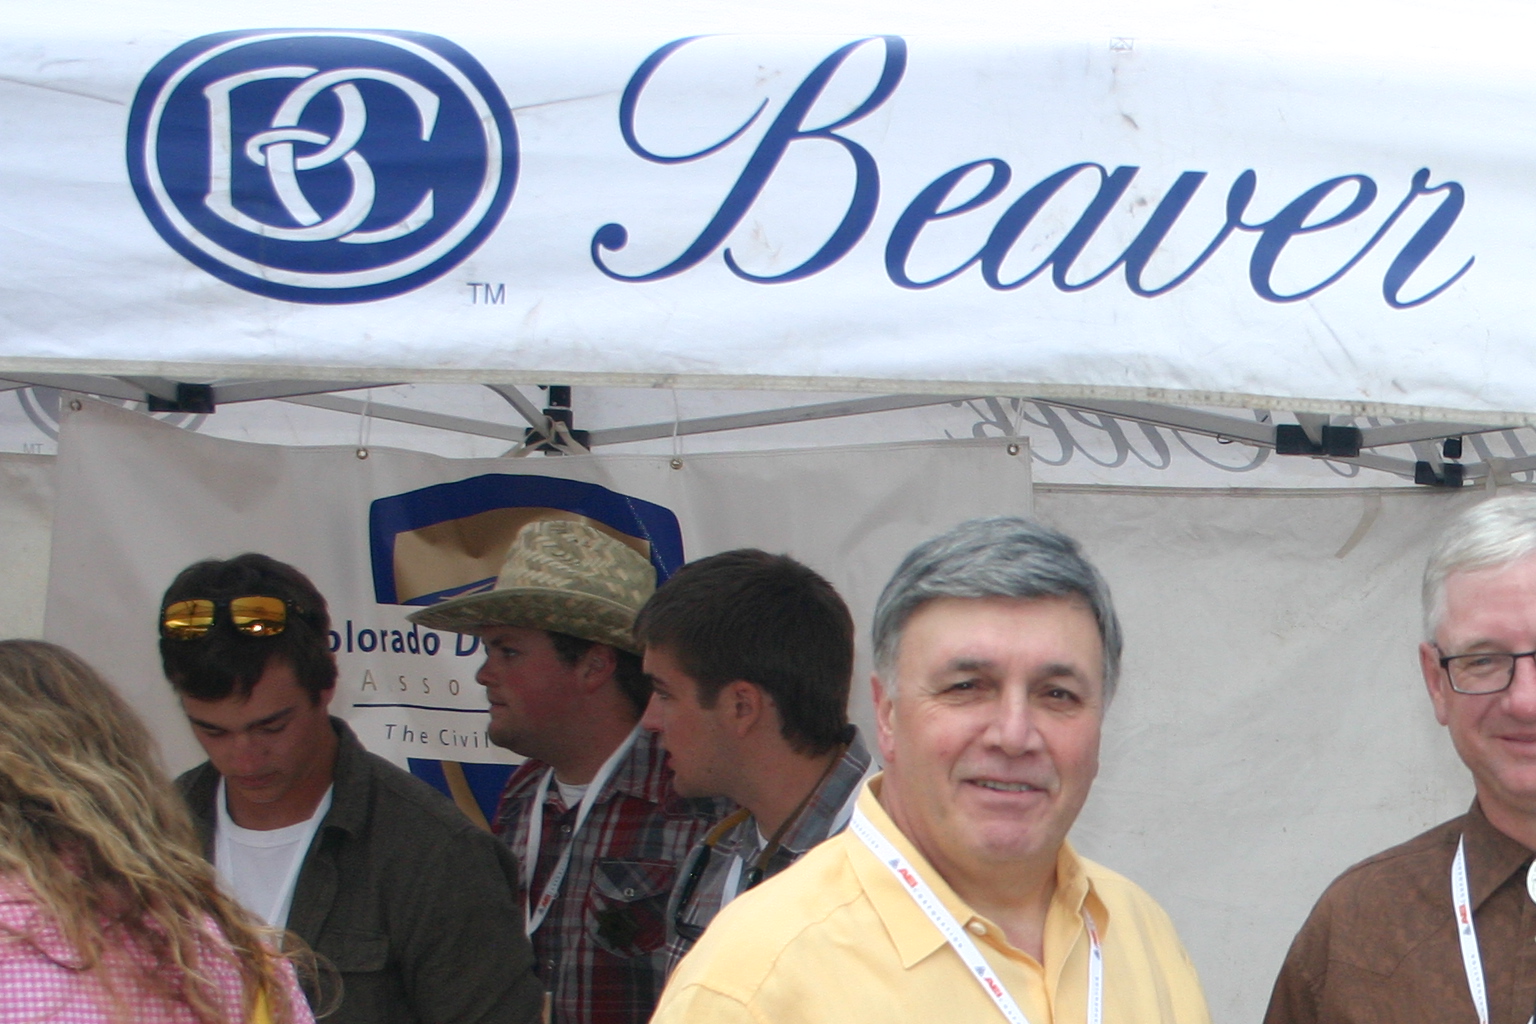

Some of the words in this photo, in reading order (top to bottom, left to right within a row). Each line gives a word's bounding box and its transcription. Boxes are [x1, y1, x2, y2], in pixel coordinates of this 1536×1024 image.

[591, 33, 1475, 310] Beaver
[466, 282, 506, 305] TM
[328, 619, 441, 656] olorado
[385, 724, 428, 743] The
[439, 729, 490, 749] Civil
